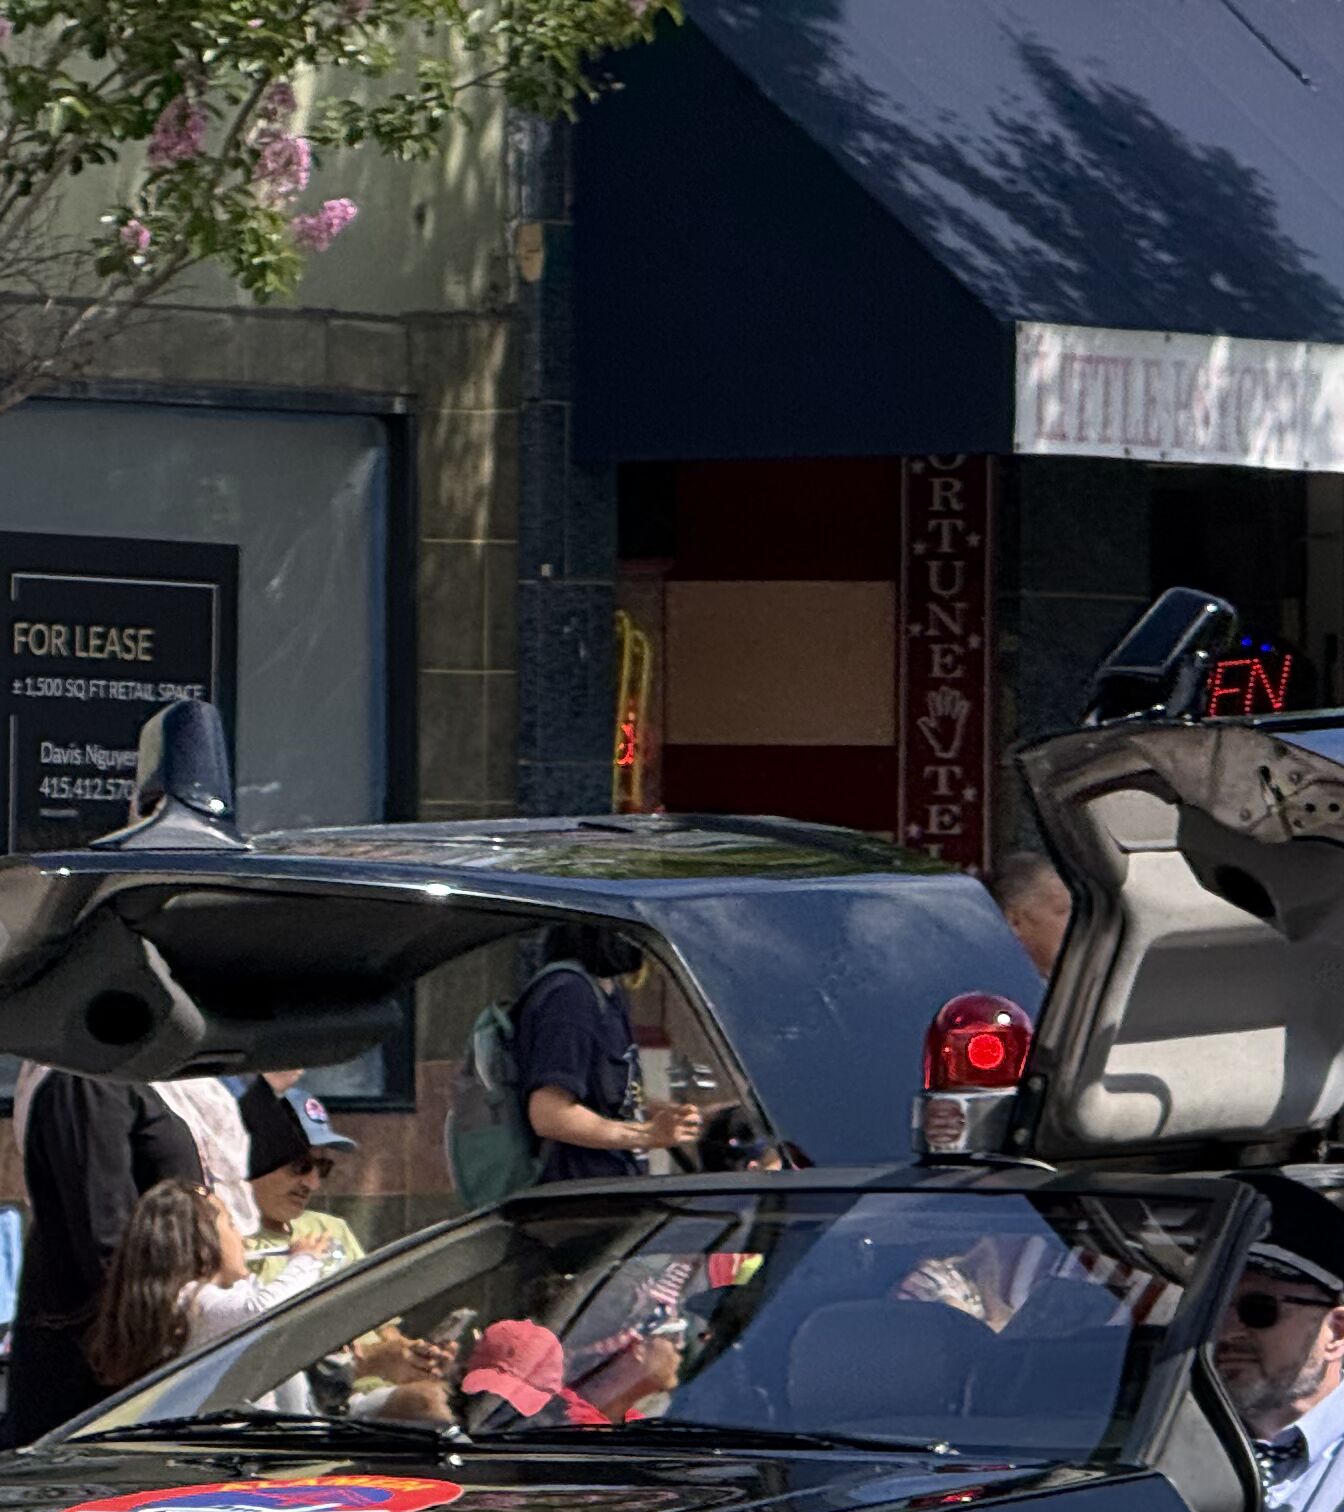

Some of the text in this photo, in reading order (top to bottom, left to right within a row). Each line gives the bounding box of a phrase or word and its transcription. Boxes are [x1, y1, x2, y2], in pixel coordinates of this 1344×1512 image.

[12, 622, 154, 662] FOR LEASE
[65, 678, 85, 700] SQ
[88, 680, 107, 698] FT
[108, 680, 155, 701] RETAIL
[40, 741, 82, 765] Davis
[39, 776, 137, 800] 415.412.570
